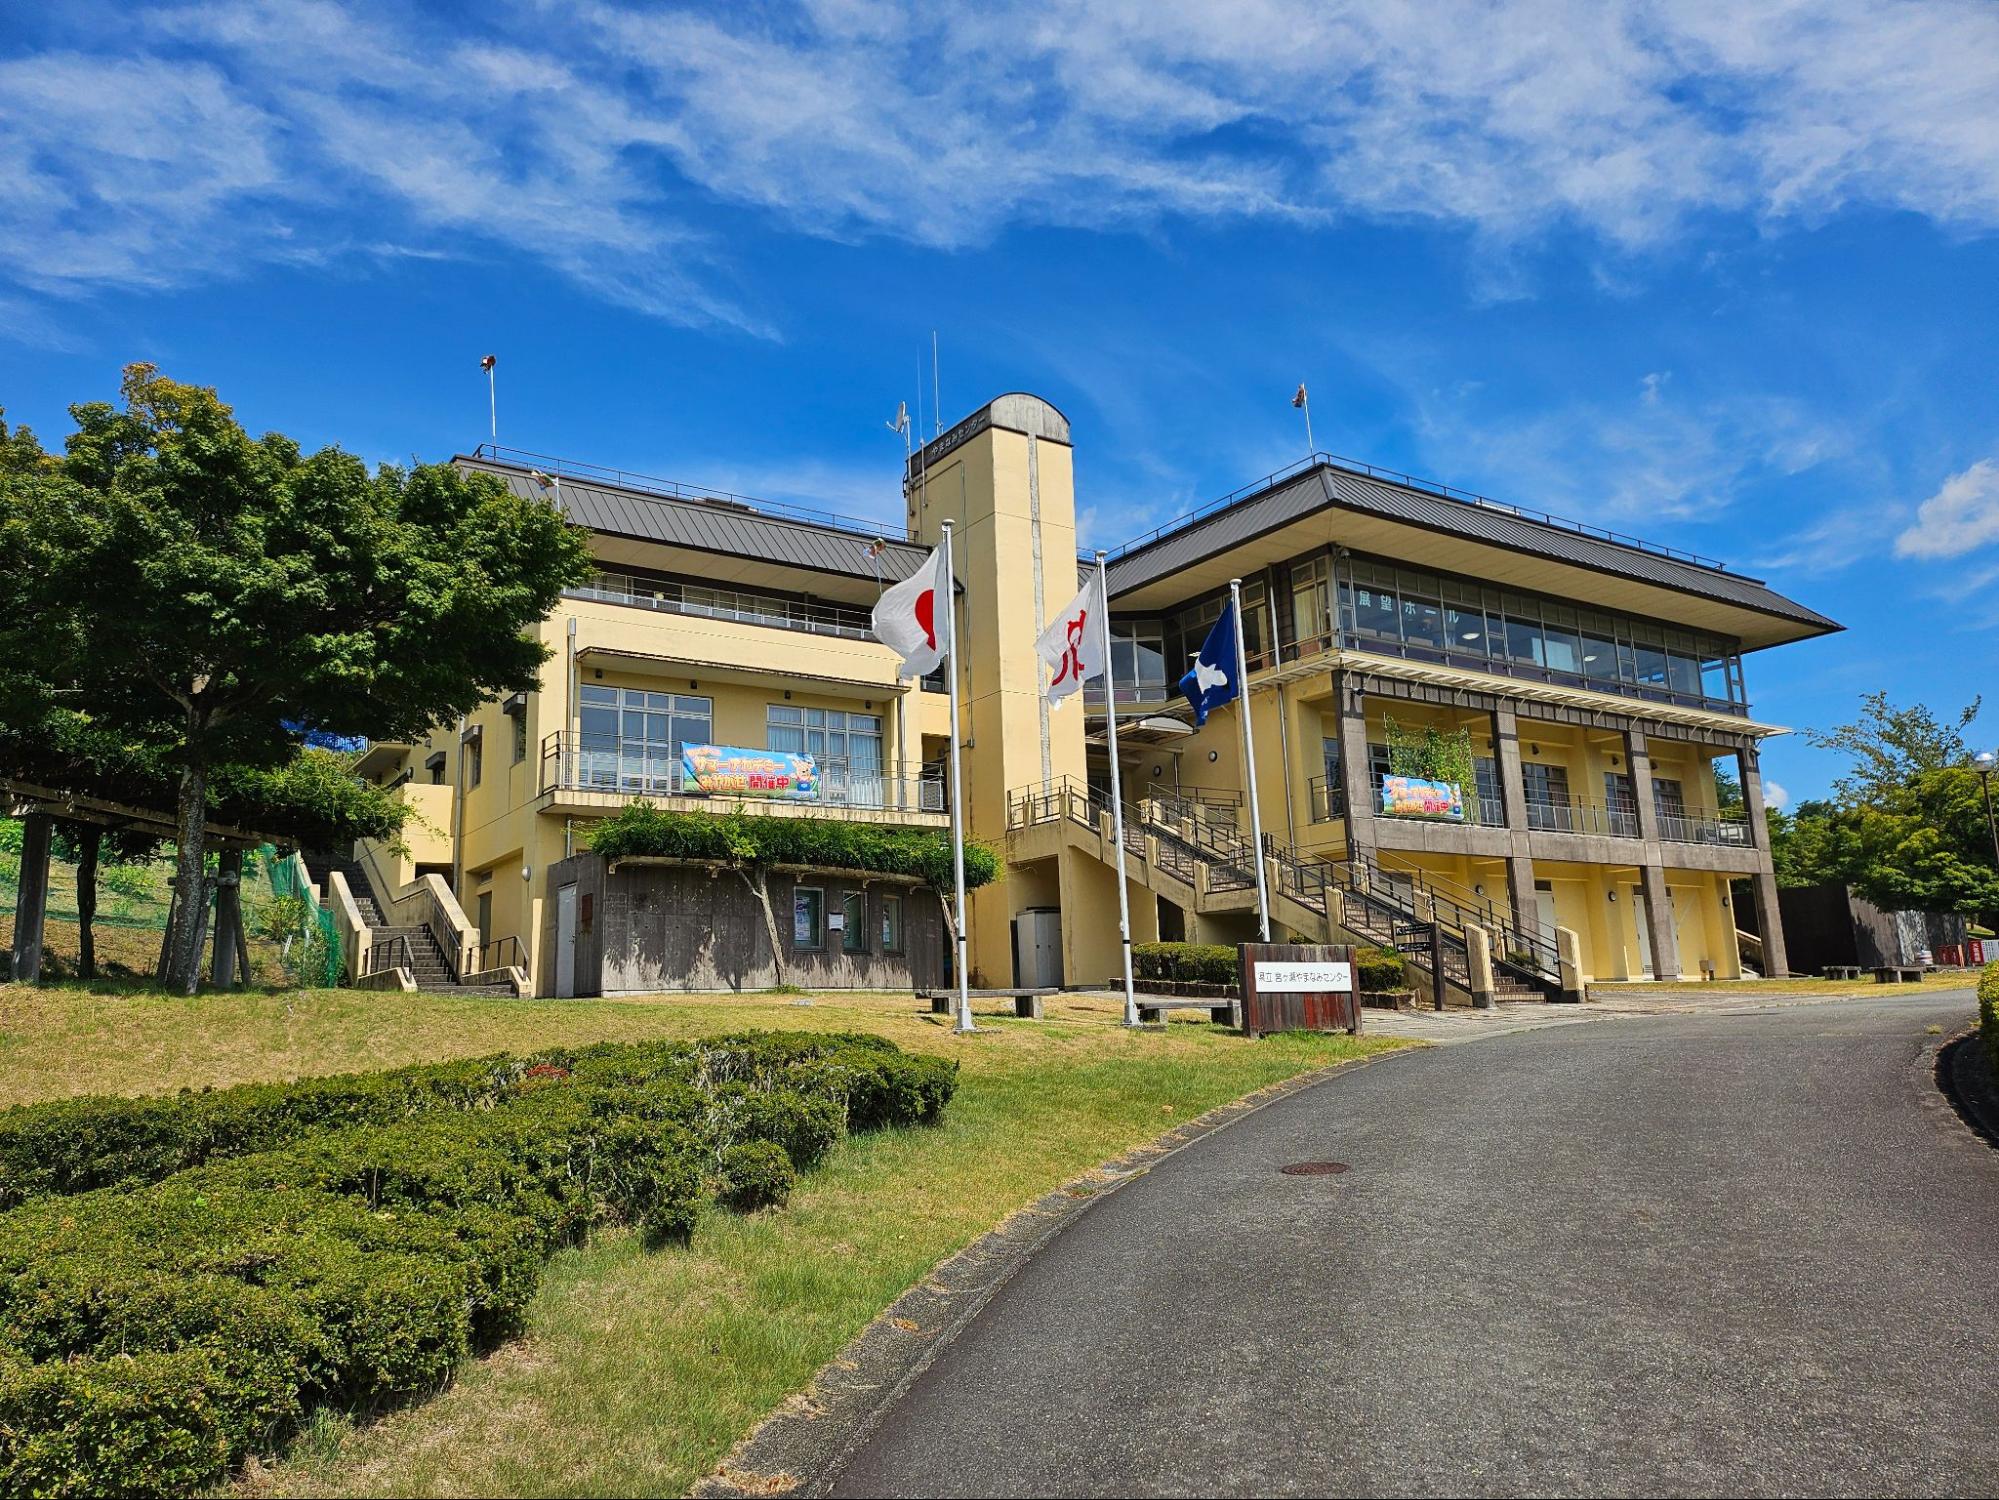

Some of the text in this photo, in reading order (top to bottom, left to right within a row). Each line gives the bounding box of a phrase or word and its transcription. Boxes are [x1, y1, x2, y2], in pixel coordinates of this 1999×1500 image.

[930, 416, 987, 458] やまなみセンター
[1359, 590, 1459, 624] 展望ホール
[748, 773, 790, 790] 開催中
